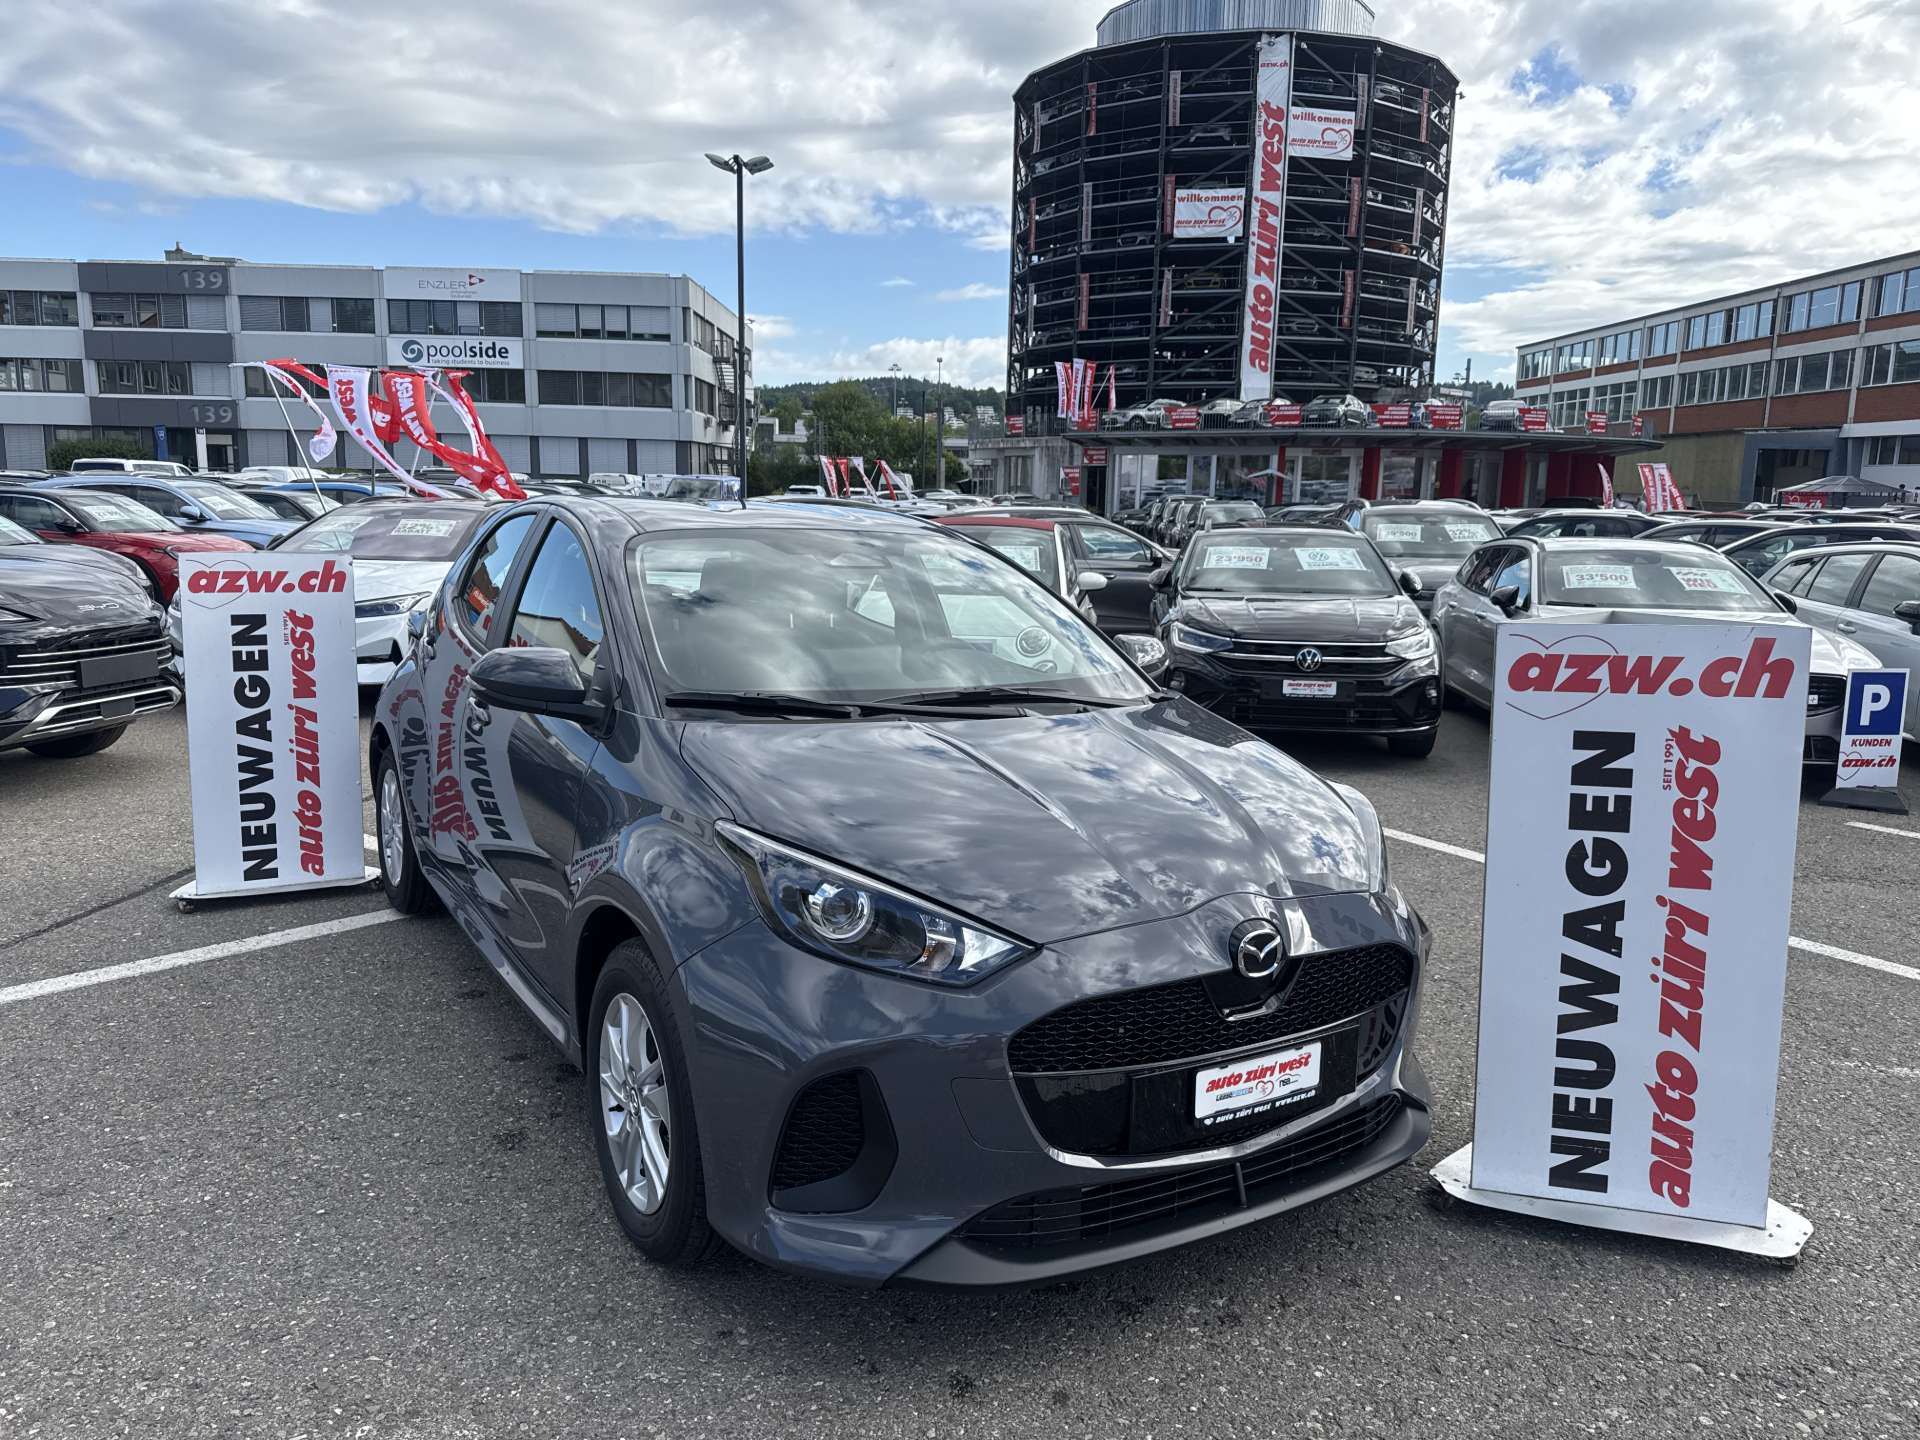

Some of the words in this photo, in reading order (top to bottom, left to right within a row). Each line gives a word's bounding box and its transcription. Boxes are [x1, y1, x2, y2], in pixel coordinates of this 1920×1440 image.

[1292, 112, 1353, 125] willkommen
[1260, 100, 1285, 192] west
[1177, 194, 1243, 203] willkommen
[1251, 196, 1280, 282] züri
[178, 271, 223, 289] 139
[418, 280, 467, 290] ENZLER
[1248, 284, 1273, 373] auto
[427, 340, 510, 363] poolside
[190, 405, 233, 424] 139
[335, 379, 358, 426] west
[187, 560, 347, 594] azw.ch
[1575, 573, 1628, 582] 33'500
[283, 608, 317, 700] west
[1507, 637, 1795, 699] azw.ch
[1860, 684, 1891, 726] P
[230, 613, 279, 882] NEUWAGEN
[287, 703, 321, 789] züri
[1664, 738, 1674, 763] 1991
[1841, 755, 1896, 768] azw.ch
[1851, 739, 1893, 748] KUNDEN
[1663, 768, 1672, 791] SEIT
[1667, 724, 1721, 891] west
[293, 789, 325, 877] auto
[1548, 730, 1636, 1194] NEUWAGEN
[1651, 895, 1710, 1053] züri
[1206, 1072, 1243, 1093] auto
[1243, 1061, 1278, 1084] züri
[1278, 1054, 1312, 1074] west
[1216, 1113, 1235, 1123] auto
[1236, 1107, 1252, 1117] züri
[1254, 1103, 1272, 1114] west
[1644, 1051, 1701, 1208] auto
